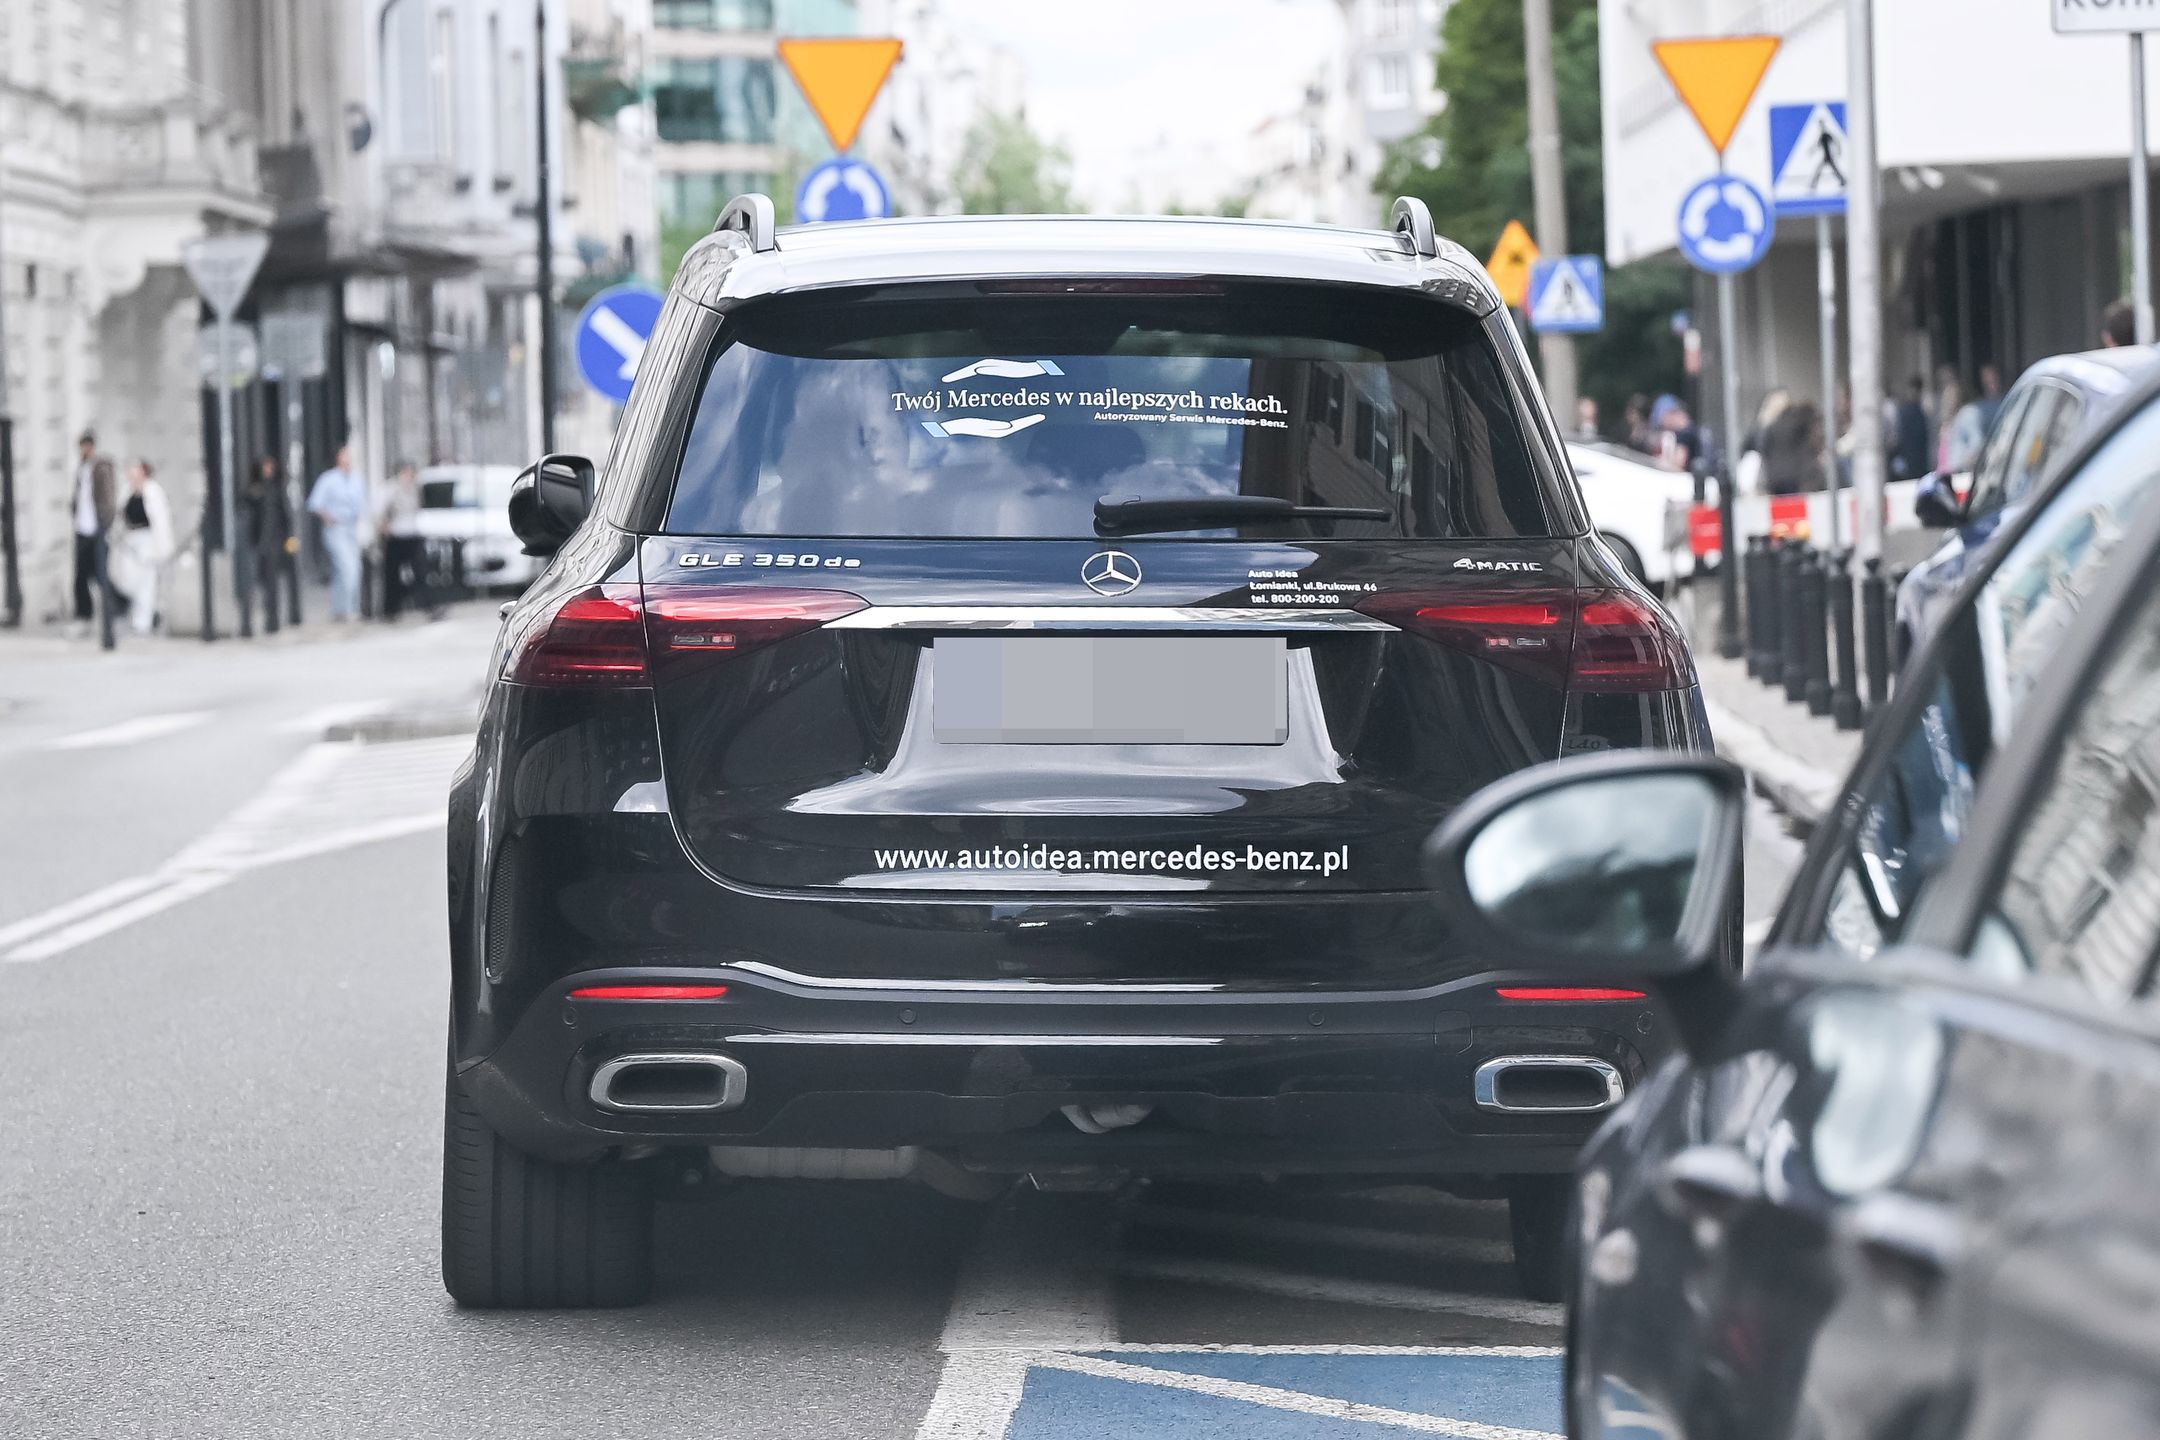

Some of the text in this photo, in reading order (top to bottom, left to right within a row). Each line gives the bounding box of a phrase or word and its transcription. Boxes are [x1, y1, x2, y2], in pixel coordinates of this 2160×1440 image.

[891, 388, 1289, 415] Twój Mercedes w najlepszych rekach.
[1094, 411, 1289, 429] Autoryzowany Serwis Mercedes-Benz.
[678, 553, 861, 567] GLE 350 de
[1453, 558, 1543, 571] 4MATIC
[1248, 570, 1299, 578] Auto Idea
[1249, 581, 1301, 592] Łomianki,
[1363, 582, 1378, 592] 46
[1251, 594, 1340, 604] tel. 800-200-200
[874, 844, 1349, 877] www.autoidea.mercedes-benz.pl
